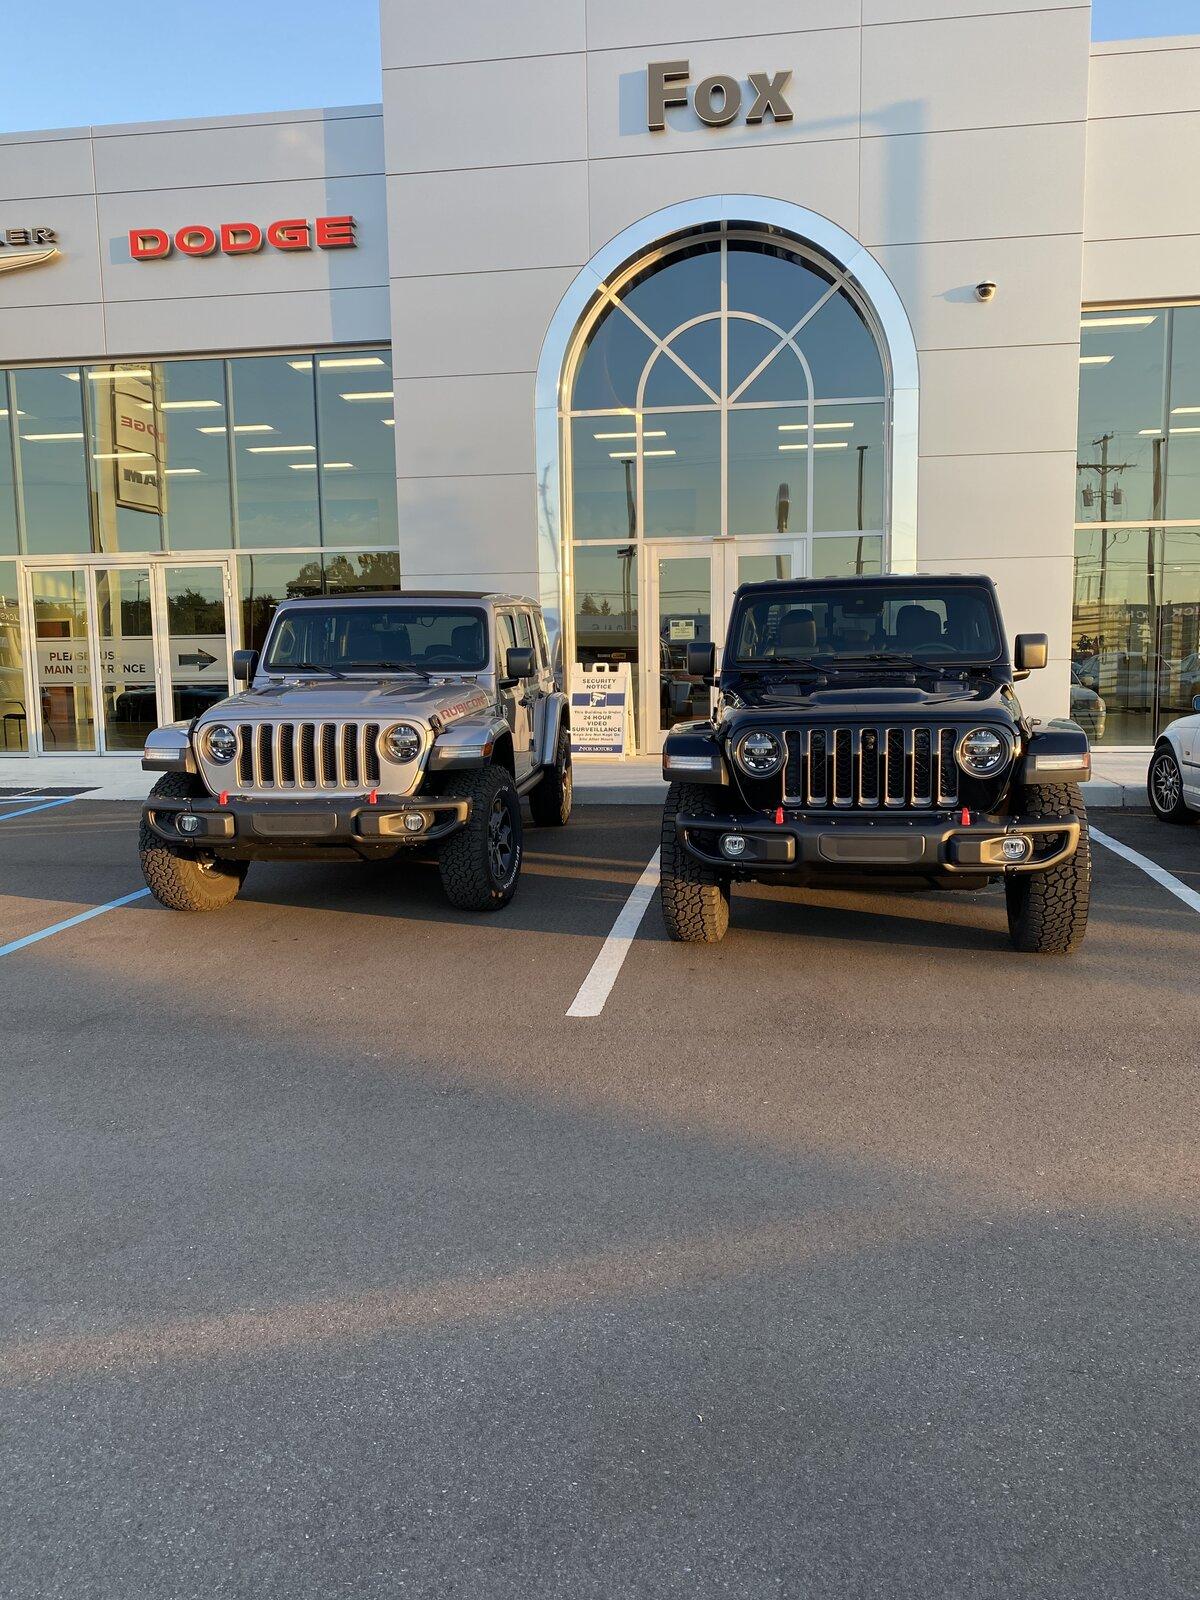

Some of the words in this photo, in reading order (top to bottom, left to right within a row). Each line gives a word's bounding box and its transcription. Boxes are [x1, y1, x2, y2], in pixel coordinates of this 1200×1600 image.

[647, 59, 794, 131] Fox
[0, 225, 57, 246] ER
[128, 215, 357, 261] DODGE
[44, 664, 73, 675] MAIN
[440, 696, 486, 719] RUBICON
